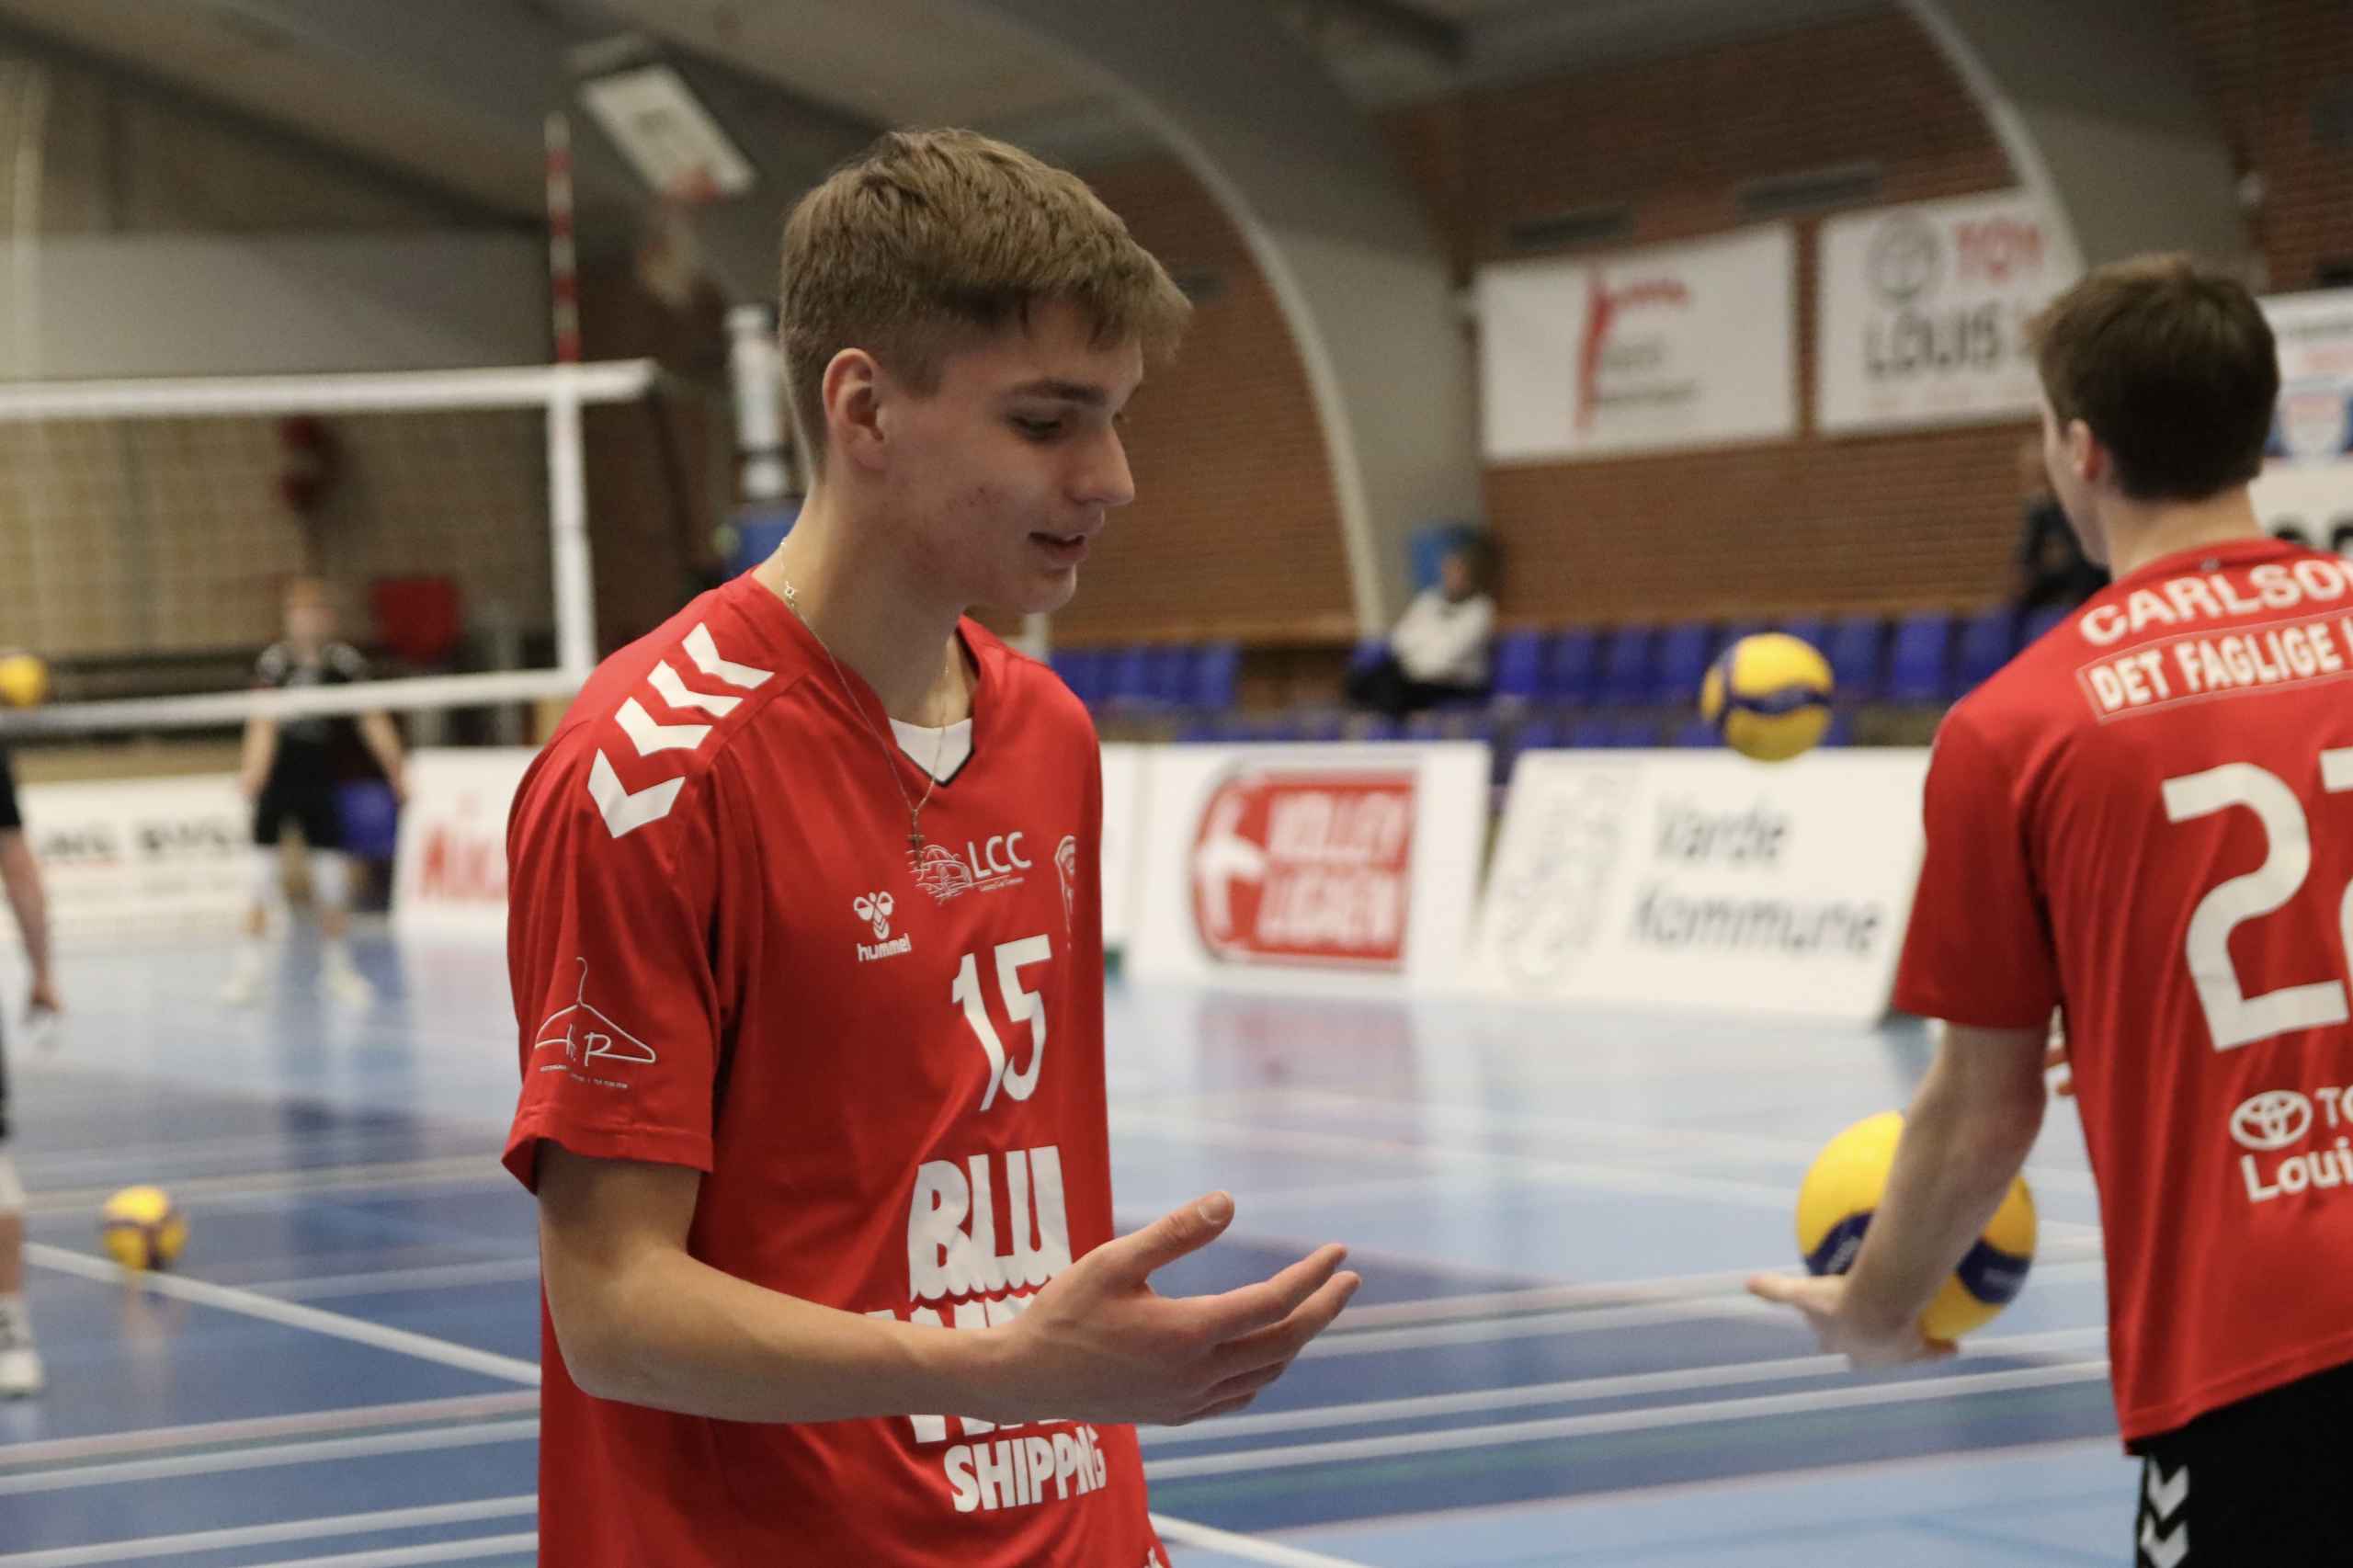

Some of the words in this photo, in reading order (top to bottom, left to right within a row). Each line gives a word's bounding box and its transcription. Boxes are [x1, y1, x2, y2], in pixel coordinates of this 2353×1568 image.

[1863, 303, 2002, 379] LOUIS
[2080, 559, 2353, 645] CARLSO
[2089, 649, 2170, 710] DET
[2181, 623, 2342, 692] FAGLIGE
[968, 832, 1031, 878] LCC
[1659, 798, 1788, 862] Varde
[857, 933, 912, 962] hummel
[1636, 884, 1881, 954] Kommune
[952, 934, 1051, 1111] 15
